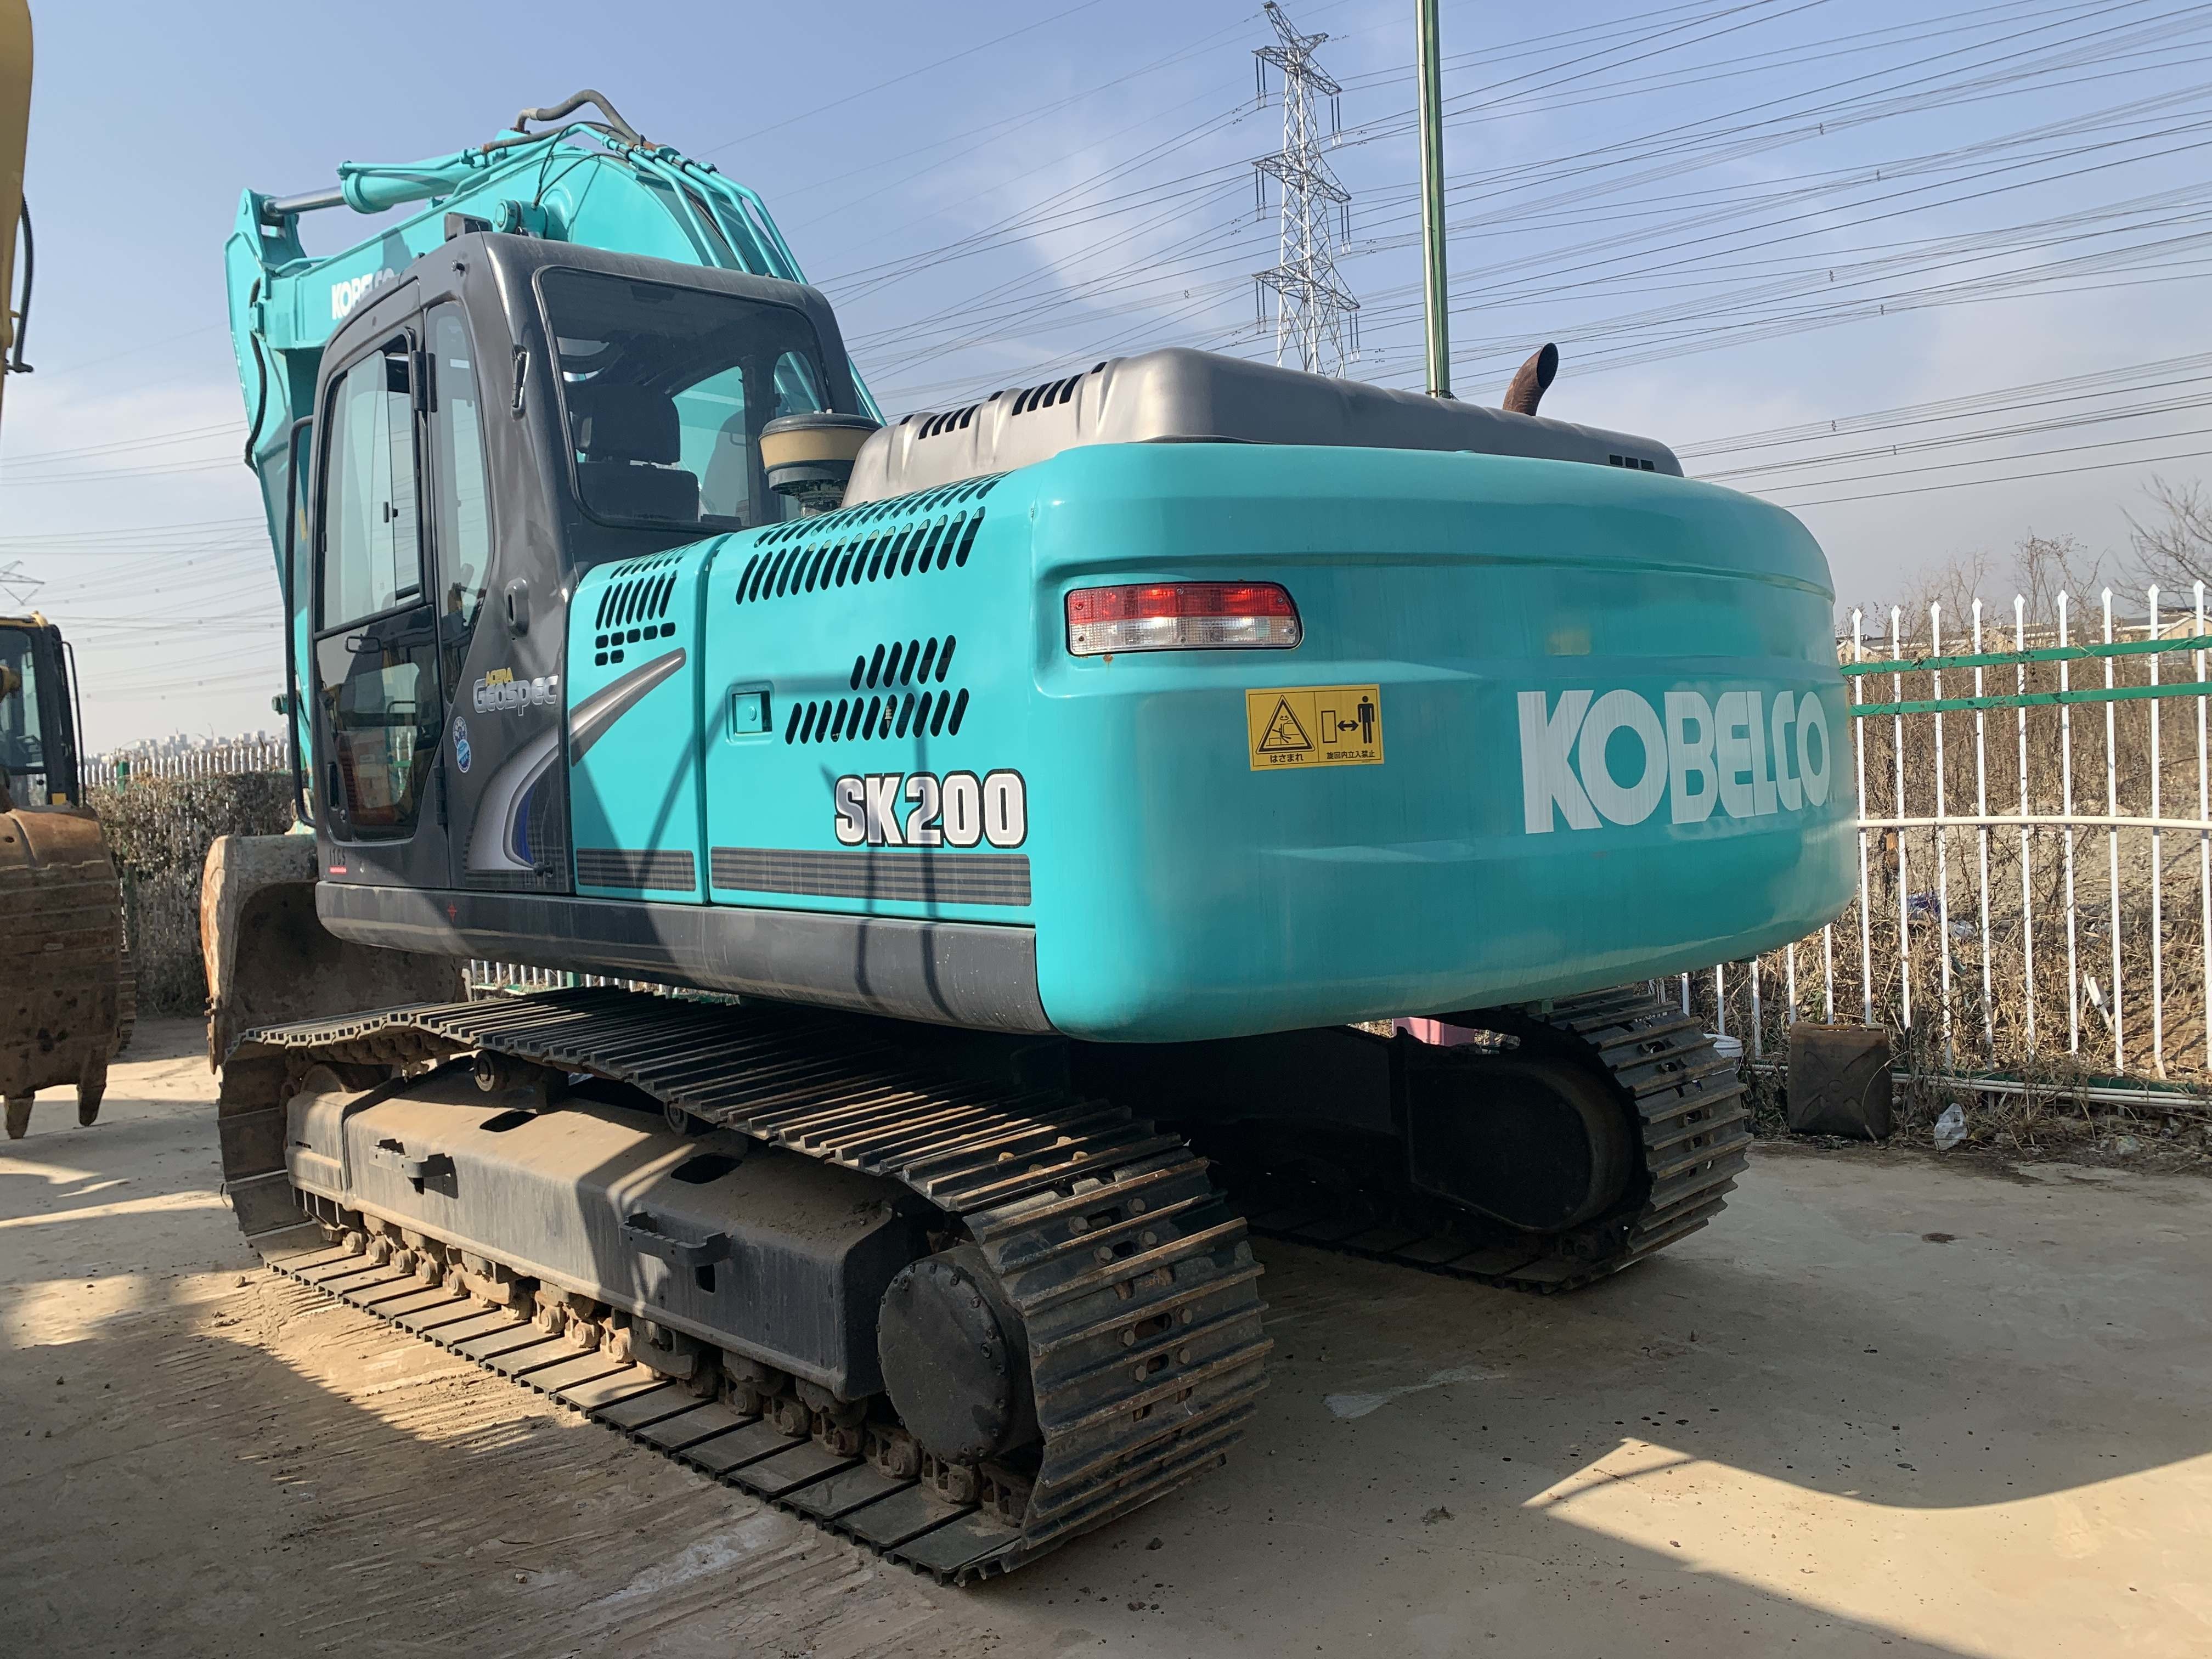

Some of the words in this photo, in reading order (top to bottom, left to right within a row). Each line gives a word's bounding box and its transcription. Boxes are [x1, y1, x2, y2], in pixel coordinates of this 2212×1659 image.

[1270, 753, 1304, 763] はさまれ
[1327, 750, 1375, 759] 旋回内立入禁止
[1517, 690, 1831, 834] KOBELCO
[834, 769, 1028, 849] SK200
